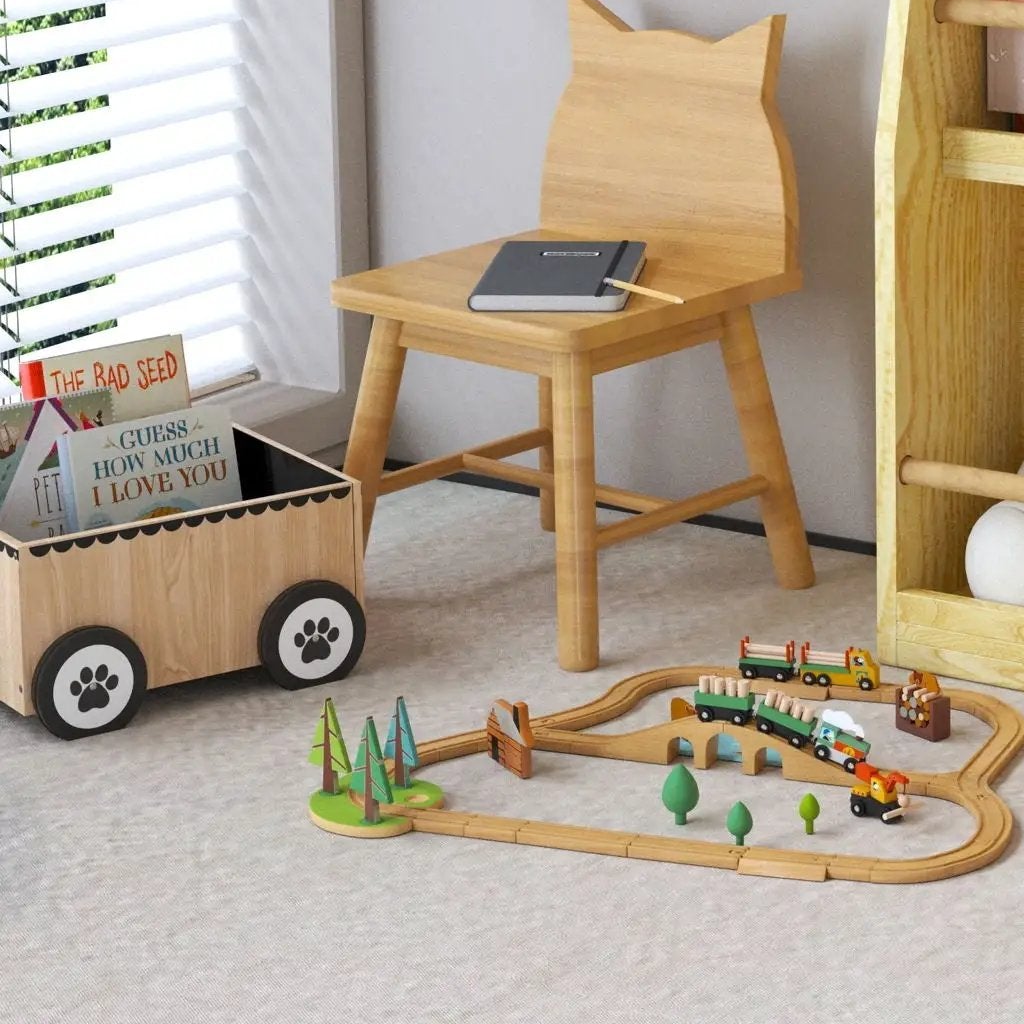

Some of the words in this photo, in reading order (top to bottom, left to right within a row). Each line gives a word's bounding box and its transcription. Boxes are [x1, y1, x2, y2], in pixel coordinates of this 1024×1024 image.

[50, 369, 85, 394] THE
[94, 362, 130, 394] BAD
[137, 350, 178, 389] SEED
[120, 420, 188, 449] GUESS
[93, 451, 146, 480] HOW
[154, 437, 220, 468] MUCH
[92, 486, 103, 506] I
[111, 471, 173, 505] LOVE
[177, 459, 227, 488] YOU
